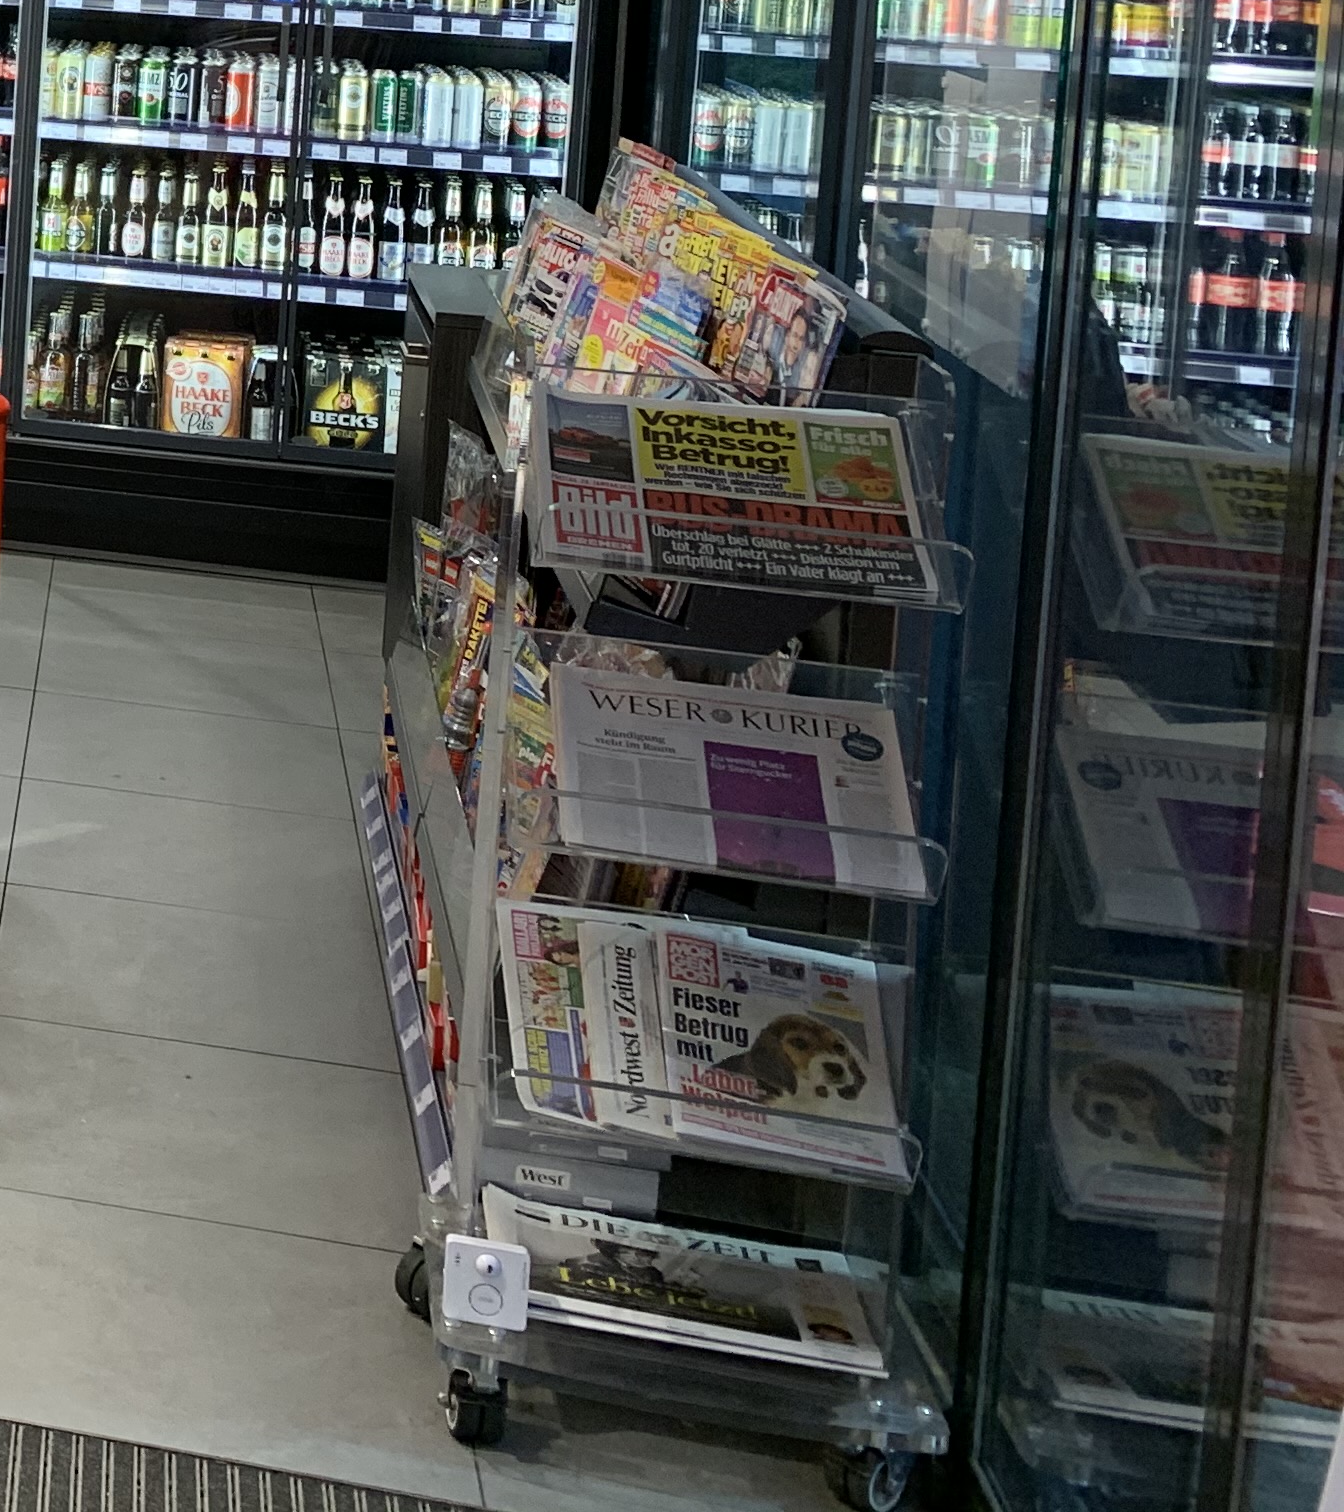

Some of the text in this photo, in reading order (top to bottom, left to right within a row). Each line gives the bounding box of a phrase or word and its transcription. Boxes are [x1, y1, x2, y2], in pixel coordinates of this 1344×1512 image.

[174, 385, 231, 404] HAAKE
[179, 399, 224, 419] BECK
[181, 411, 215, 433] Pils
[310, 410, 379, 429] BECK'S
[635, 408, 797, 440] Vorsicht,
[641, 426, 796, 454] Inkasso-
[812, 427, 888, 447] Frisch
[652, 445, 790, 474] Betrug!
[654, 463, 676, 472] Wie
[677, 465, 725, 477] RENTNER
[557, 484, 636, 545] Bild
[651, 524, 725, 546] Überschlag
[728, 531, 749, 547] bei
[751, 537, 791, 551] Glätte
[824, 543, 832, 555] 2
[663, 552, 733, 572] Gurtpflicht
[766, 561, 786, 576] Ein
[790, 564, 824, 579] Vater
[828, 566, 863, 584] klagt
[865, 571, 885, 584] an
[671, 540, 695, 556] tot,
[698, 542, 714, 555] 20
[717, 546, 768, 561] verletzt
[800, 553, 874, 570] Diskussion
[876, 559, 899, 571] um
[588, 689, 706, 723] WESER
[604, 728, 666, 744] Kündigung
[642, 743, 676, 755] Raum
[614, 944, 636, 1017] Zeitung
[672, 987, 741, 1019] Fieser
[674, 1013, 749, 1047] Betrug
[676, 1039, 715, 1063] mit
[560, 1213, 777, 1265] DIE ZEIT
